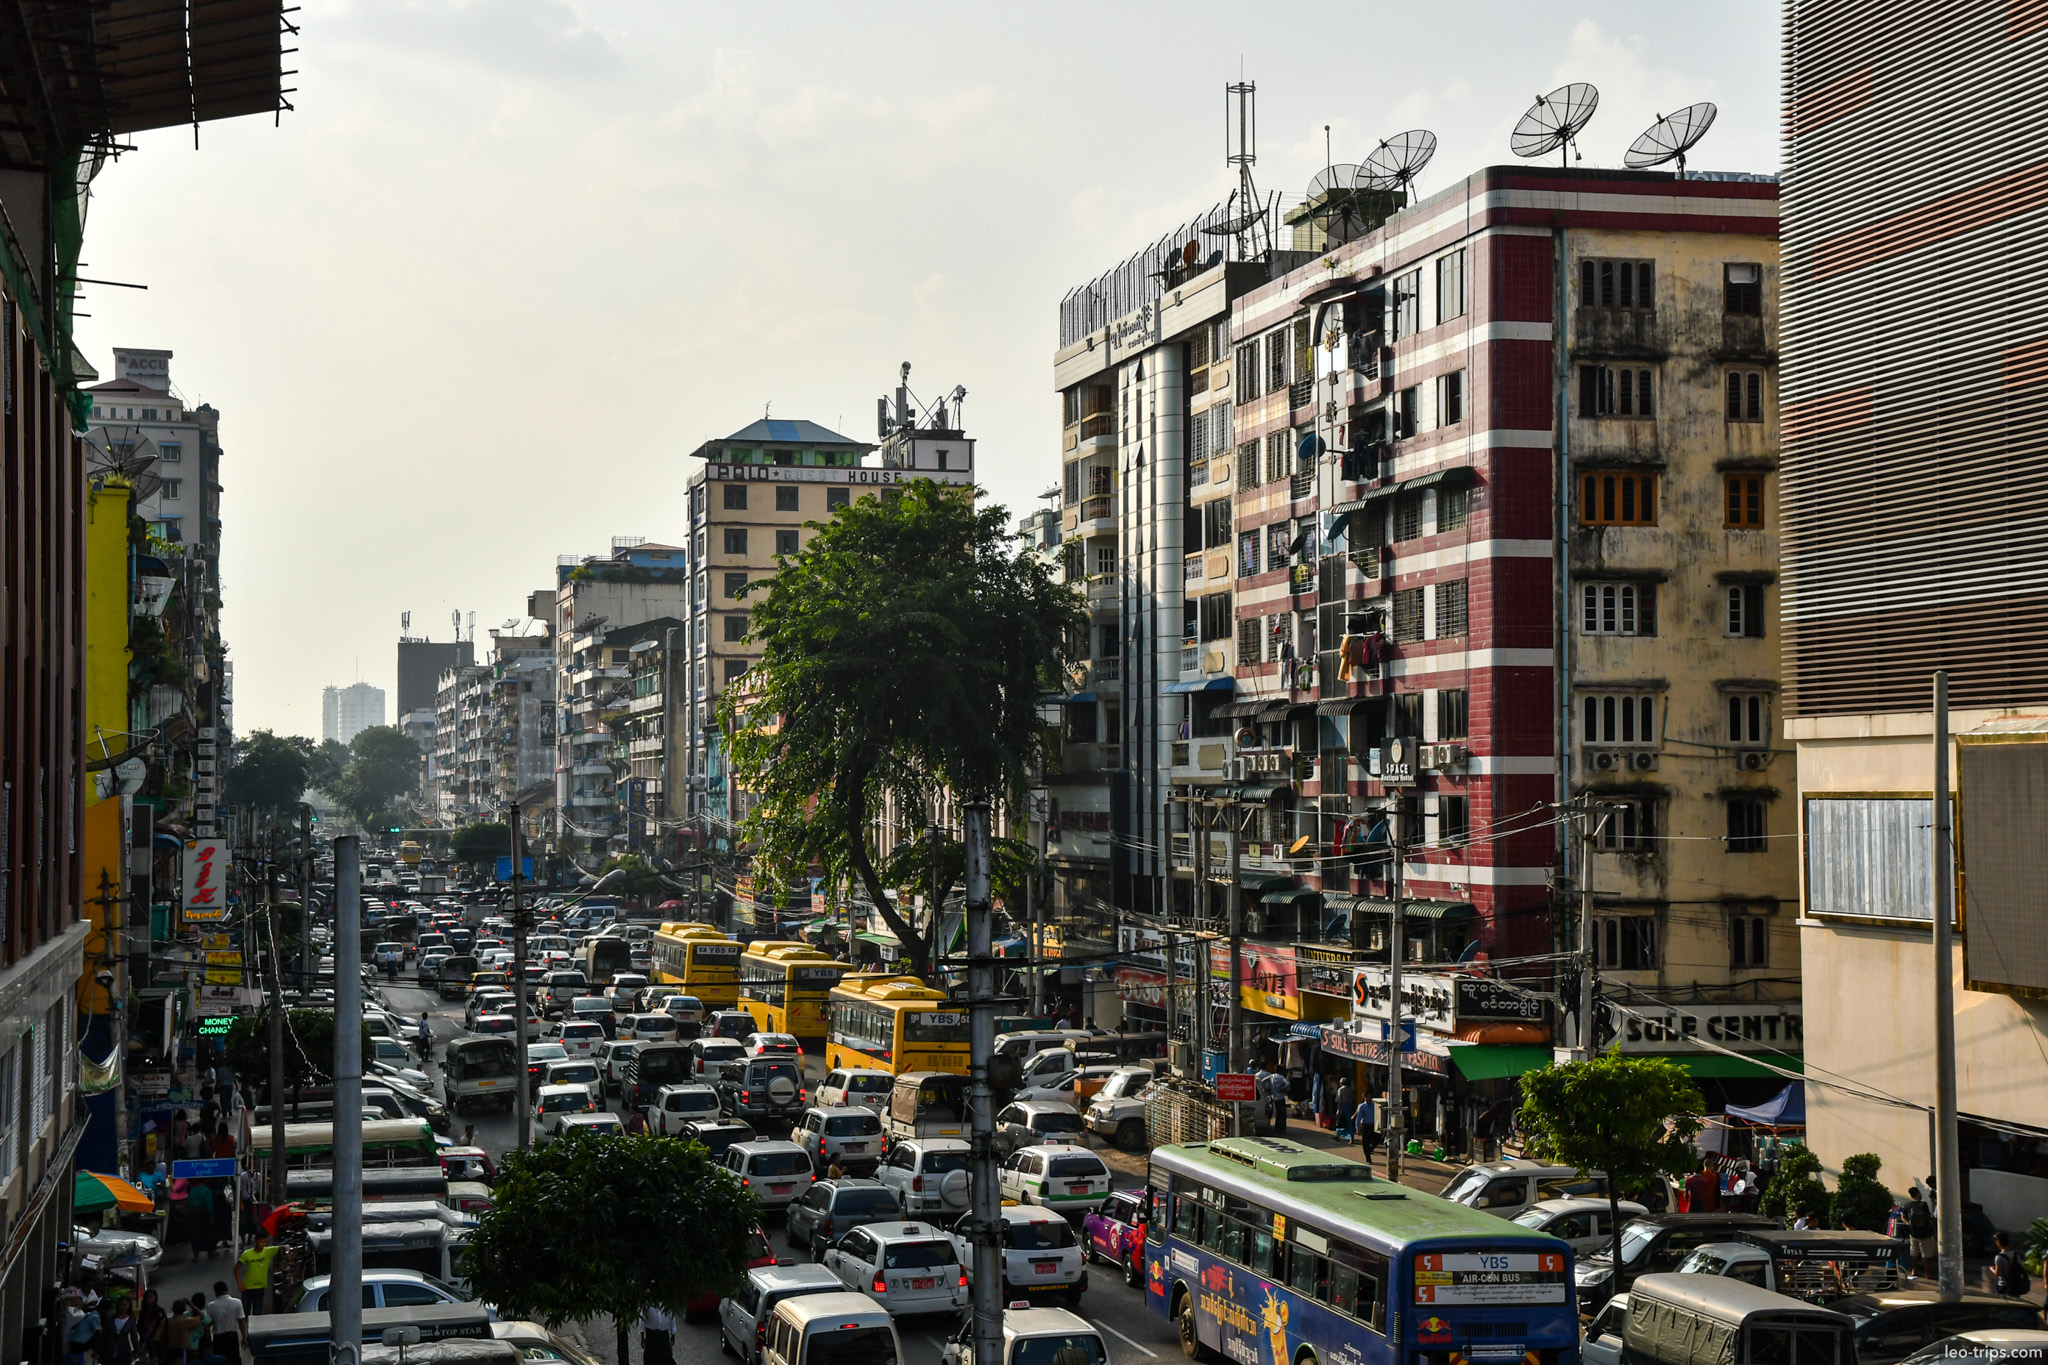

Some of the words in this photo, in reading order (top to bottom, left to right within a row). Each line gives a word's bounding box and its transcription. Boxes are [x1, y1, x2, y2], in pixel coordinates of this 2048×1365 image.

[784, 470, 839, 482] GUEST
[849, 471, 902, 484] HOUSE
[1386, 763, 1409, 774] SPACE
[814, 969, 833, 977] YBS
[1251, 963, 1286, 996] LOVE
[205, 1018, 234, 1026] MONEY
[930, 1015, 954, 1024] YBS
[1626, 1016, 1698, 1041] SULE
[1707, 1015, 1803, 1041] CENTR
[1331, 1034, 1348, 1053] SULE
[1479, 1256, 1509, 1269] YBS
[1462, 1274, 1500, 1283] AIR-CON
[1503, 1273, 1521, 1282] BUS
[459, 1326, 483, 1335] STAR
